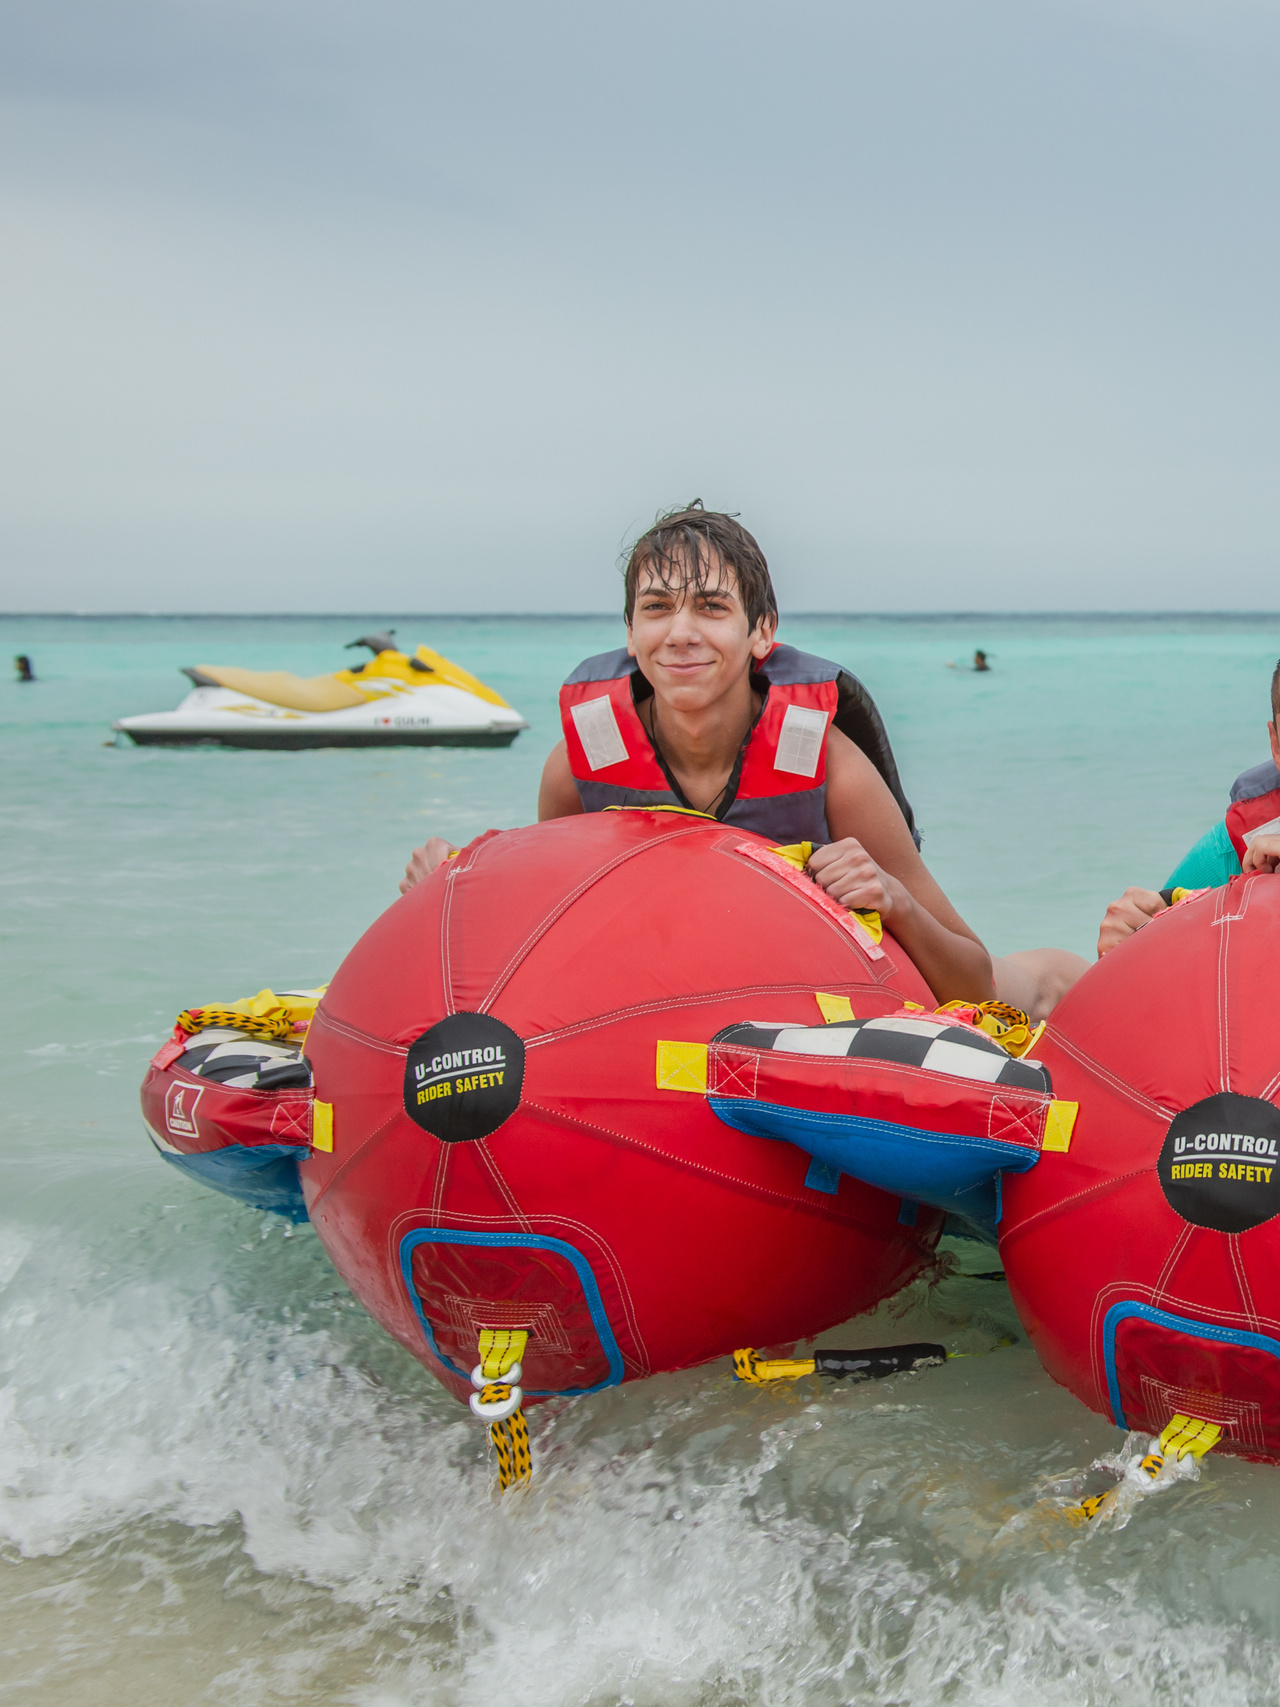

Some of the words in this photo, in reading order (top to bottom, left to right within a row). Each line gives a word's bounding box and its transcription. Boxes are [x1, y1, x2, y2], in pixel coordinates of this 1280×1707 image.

[415, 1045, 506, 1081] U-CONTROL
[416, 1082, 452, 1105] RIDER
[455, 1071, 505, 1094] SAFETY
[1174, 1133, 1279, 1156] U-CONTROL
[1171, 1163, 1213, 1180] RIDER
[1218, 1163, 1273, 1183] SAFETY
